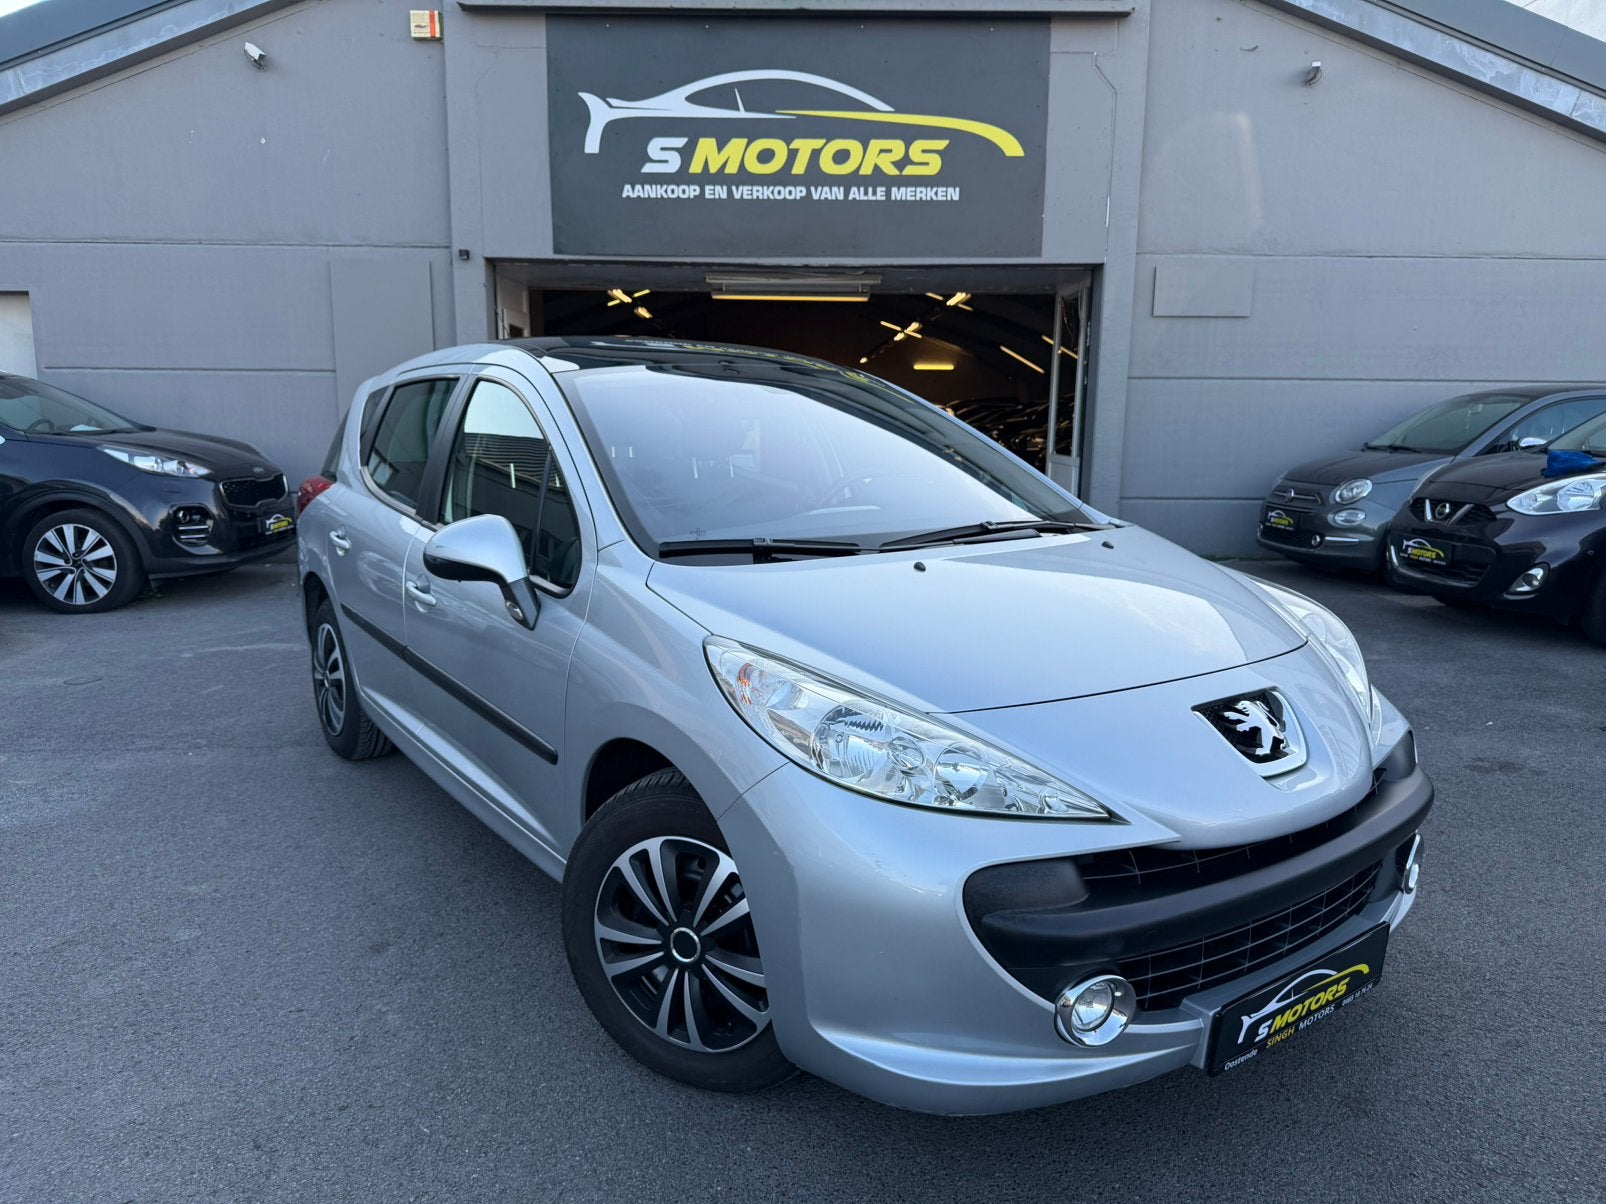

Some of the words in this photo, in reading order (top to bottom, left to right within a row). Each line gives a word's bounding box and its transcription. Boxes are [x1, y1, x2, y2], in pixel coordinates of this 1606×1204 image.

[641, 137, 688, 173] S
[688, 138, 950, 176] MOTORS
[622, 184, 700, 198] AANKOOP
[705, 185, 727, 199] EN
[732, 185, 806, 200] VERKOOP
[810, 186, 844, 200] VAN
[848, 186, 886, 200] ALLE
[891, 187, 960, 201] MERKEN
[1411, 548, 1437, 559] MOTORS
[1254, 1019, 1273, 1043] S
[1269, 977, 1350, 1034] MOTORS
[1266, 1026, 1295, 1048] SINGH
[1299, 1004, 1335, 1030] MOTORS
